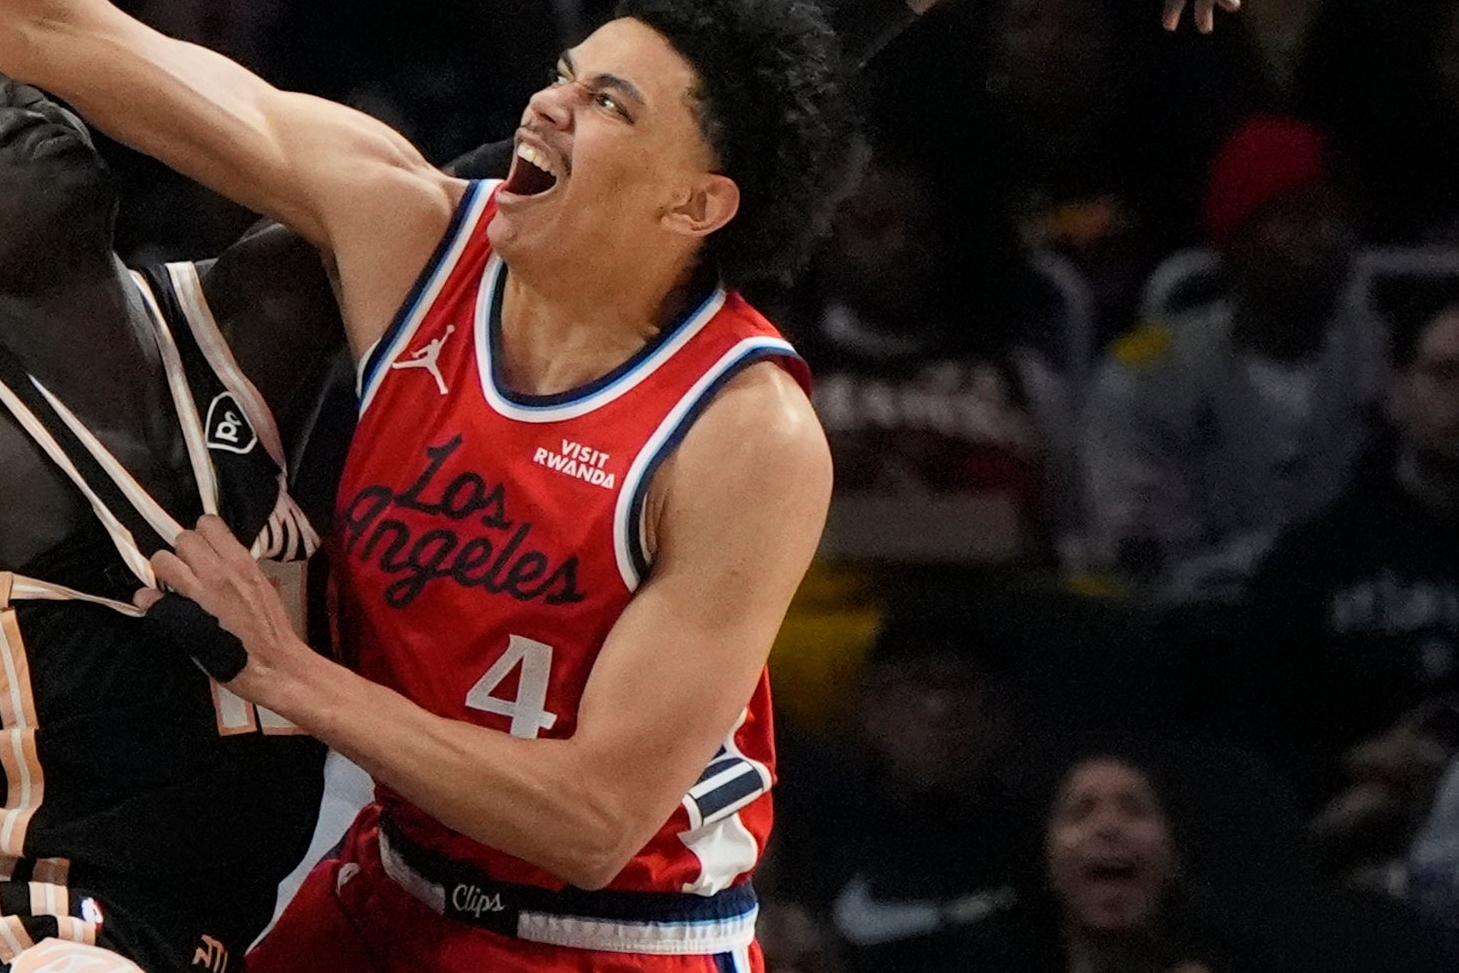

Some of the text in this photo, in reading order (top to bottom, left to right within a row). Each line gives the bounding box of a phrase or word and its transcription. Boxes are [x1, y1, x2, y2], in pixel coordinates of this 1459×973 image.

[392, 432, 512, 528] Los
[533, 447, 615, 489] RWANDA
[562, 439, 609, 468] VISIT
[345, 484, 586, 609] Angeles
[465, 633, 558, 739] 4
[452, 883, 505, 918] Clips
